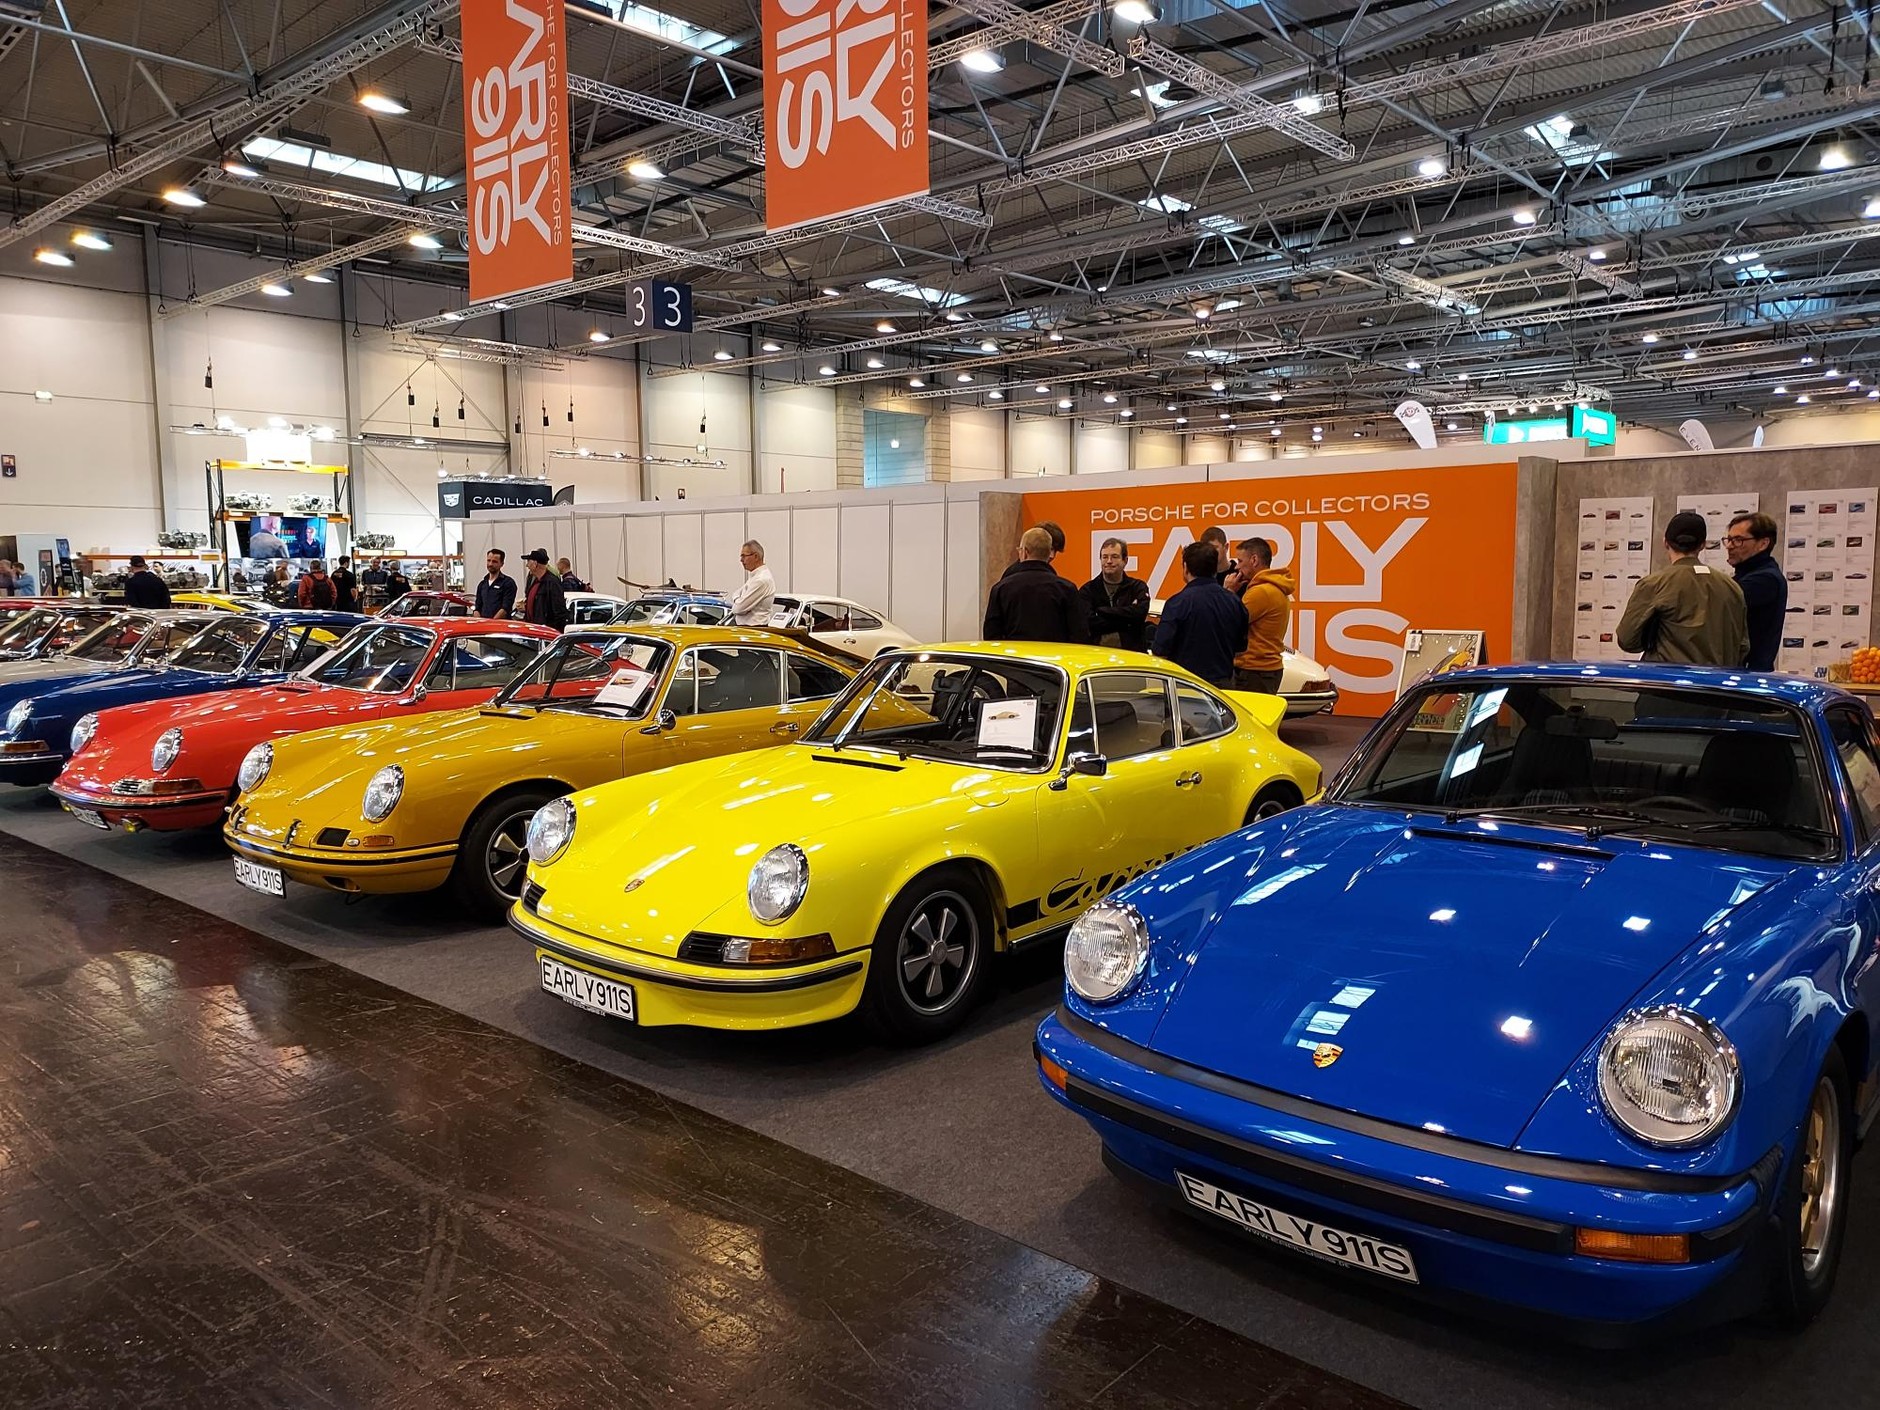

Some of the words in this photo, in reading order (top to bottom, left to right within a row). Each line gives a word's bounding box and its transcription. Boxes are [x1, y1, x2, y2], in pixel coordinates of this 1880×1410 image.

[547, 43, 557, 90] FOR
[776, 0, 833, 169] 11S
[471, 66, 511, 255] 911S
[549, 95, 562, 246] COLLECTORS
[633, 286, 646, 327] 3
[663, 286, 681, 327] 3
[472, 496, 544, 507] CADILLAC
[1090, 505, 1195, 525] PORSCHE
[1201, 502, 1248, 519] FOR
[1254, 492, 1431, 516] COLLECTORS
[234, 859, 283, 891] EARLY911S
[542, 960, 632, 1014] EARLY911S
[1181, 1177, 1411, 1276] EARLY911S
